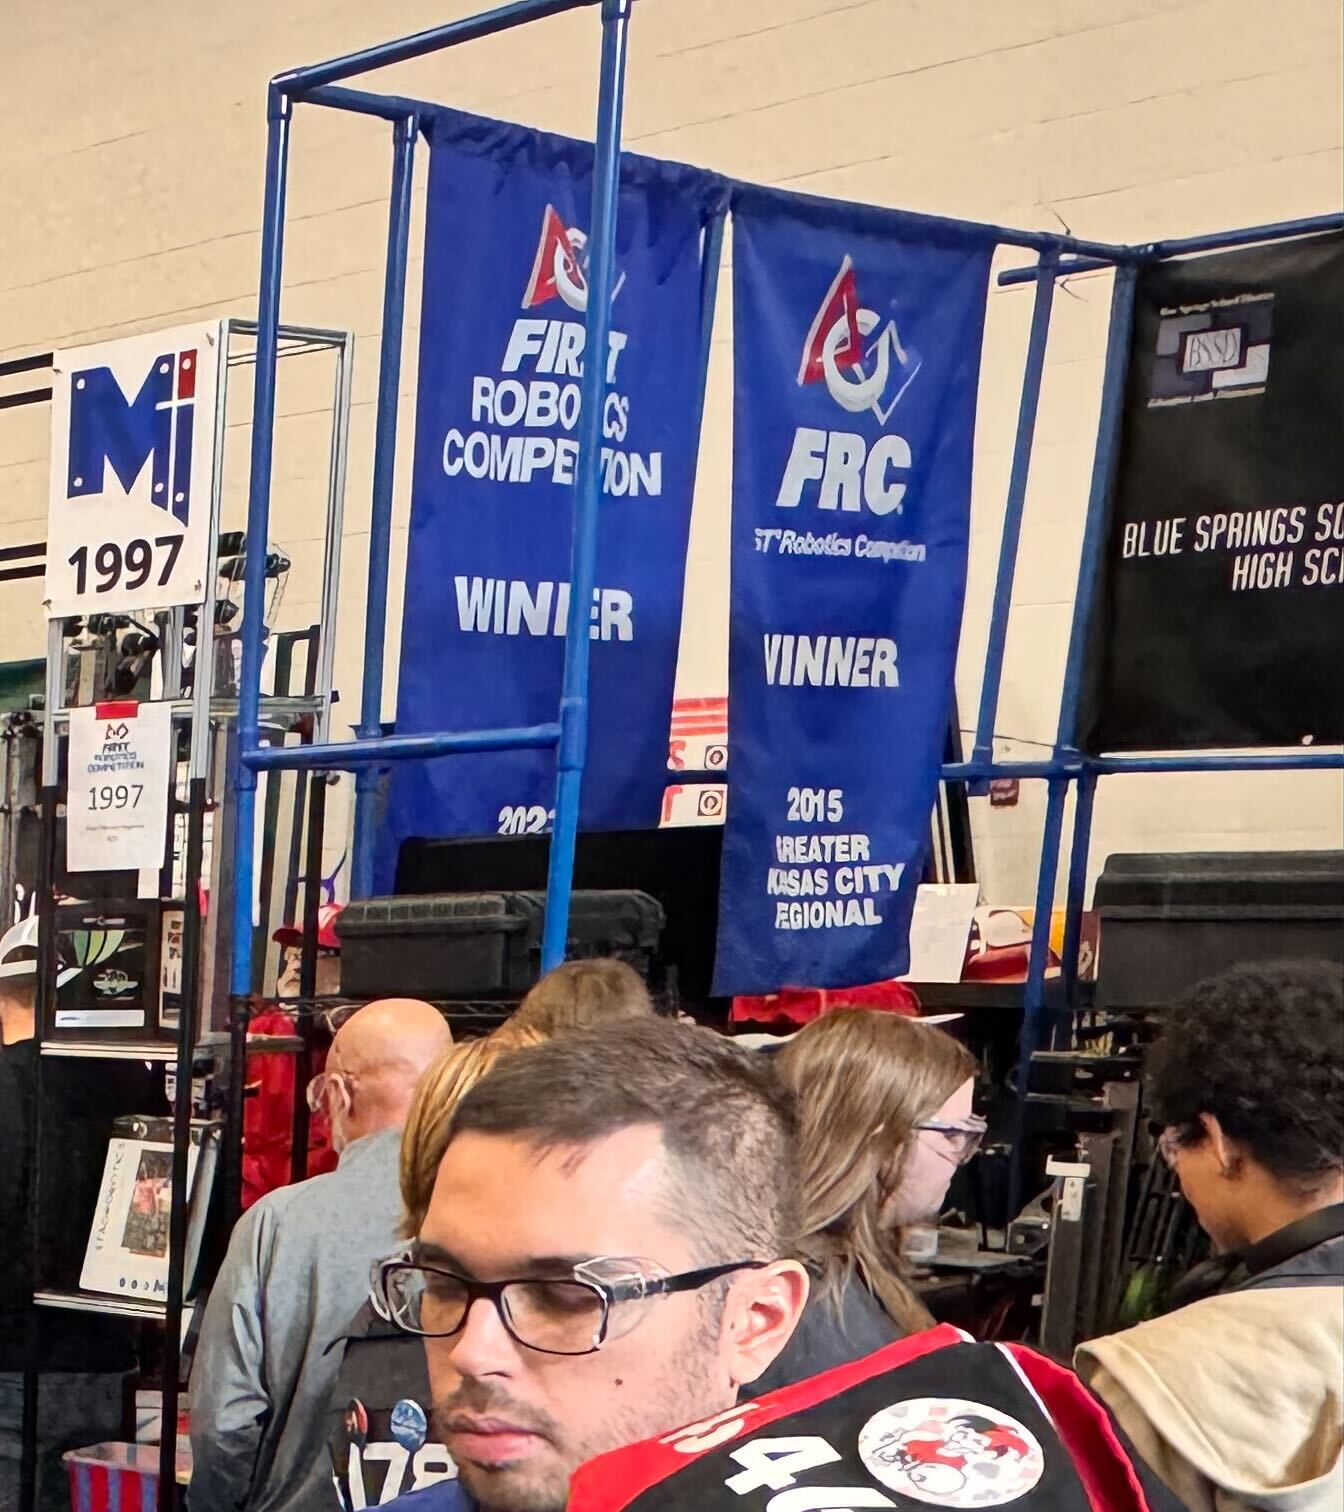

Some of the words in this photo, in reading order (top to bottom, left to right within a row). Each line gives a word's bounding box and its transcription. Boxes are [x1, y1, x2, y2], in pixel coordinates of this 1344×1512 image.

[502, 318, 628, 384] FIRT
[472, 376, 629, 442] ROBOCS
[443, 428, 663, 497] COMPEION
[776, 427, 913, 516] FRC
[1123, 517, 1187, 558] BLUE
[1194, 506, 1307, 552] SPRINGS
[68, 534, 184, 595] 1997
[1232, 551, 1294, 591] HIGH
[88, 784, 144, 811] 1997
[498, 805, 557, 835] 202
[787, 786, 844, 822] 2015
[767, 868, 829, 897] KSAS
[834, 862, 906, 895] CITY
[775, 898, 883, 930] EGIONAL
